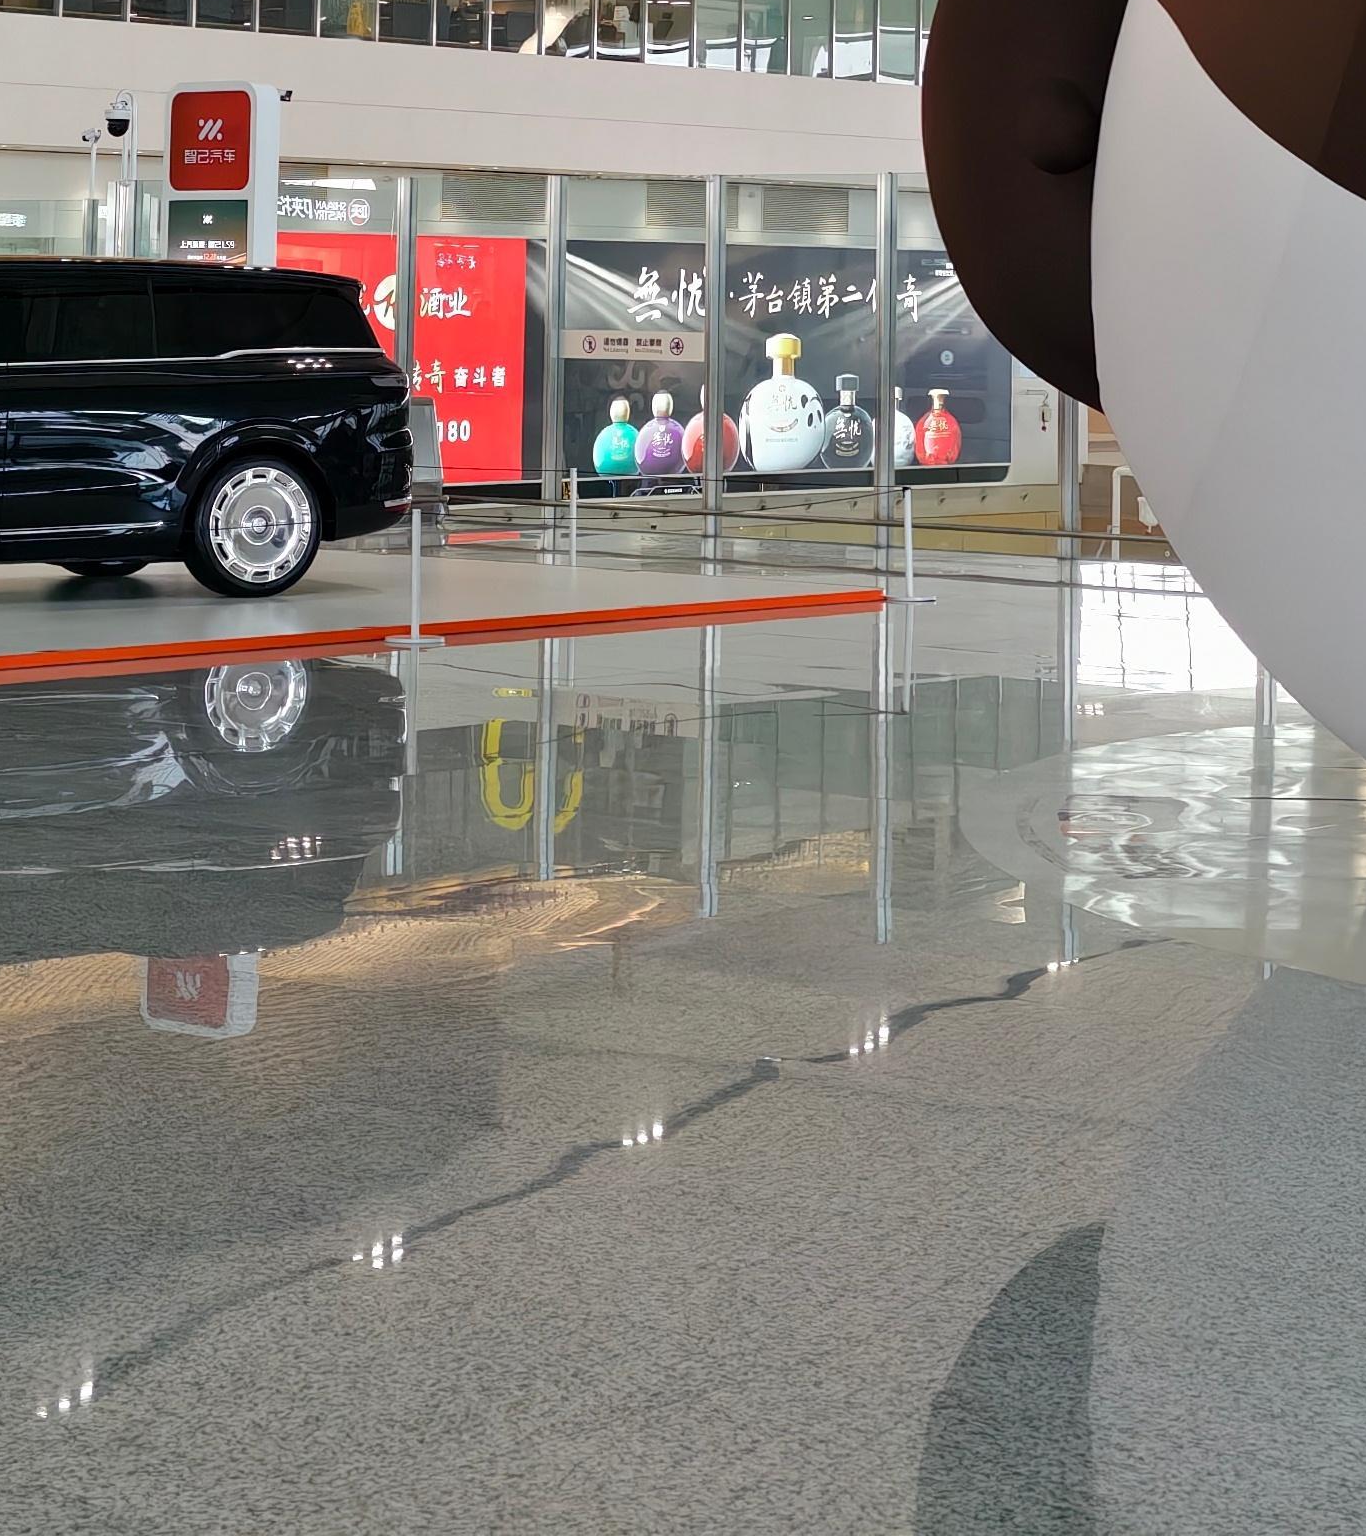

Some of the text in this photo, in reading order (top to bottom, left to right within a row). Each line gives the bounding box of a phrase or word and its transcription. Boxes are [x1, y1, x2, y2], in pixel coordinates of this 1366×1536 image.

[184, 149, 236, 164] 智己汽车
[420, 287, 471, 319] 酒业
[454, 366, 506, 388] 奋斗者
